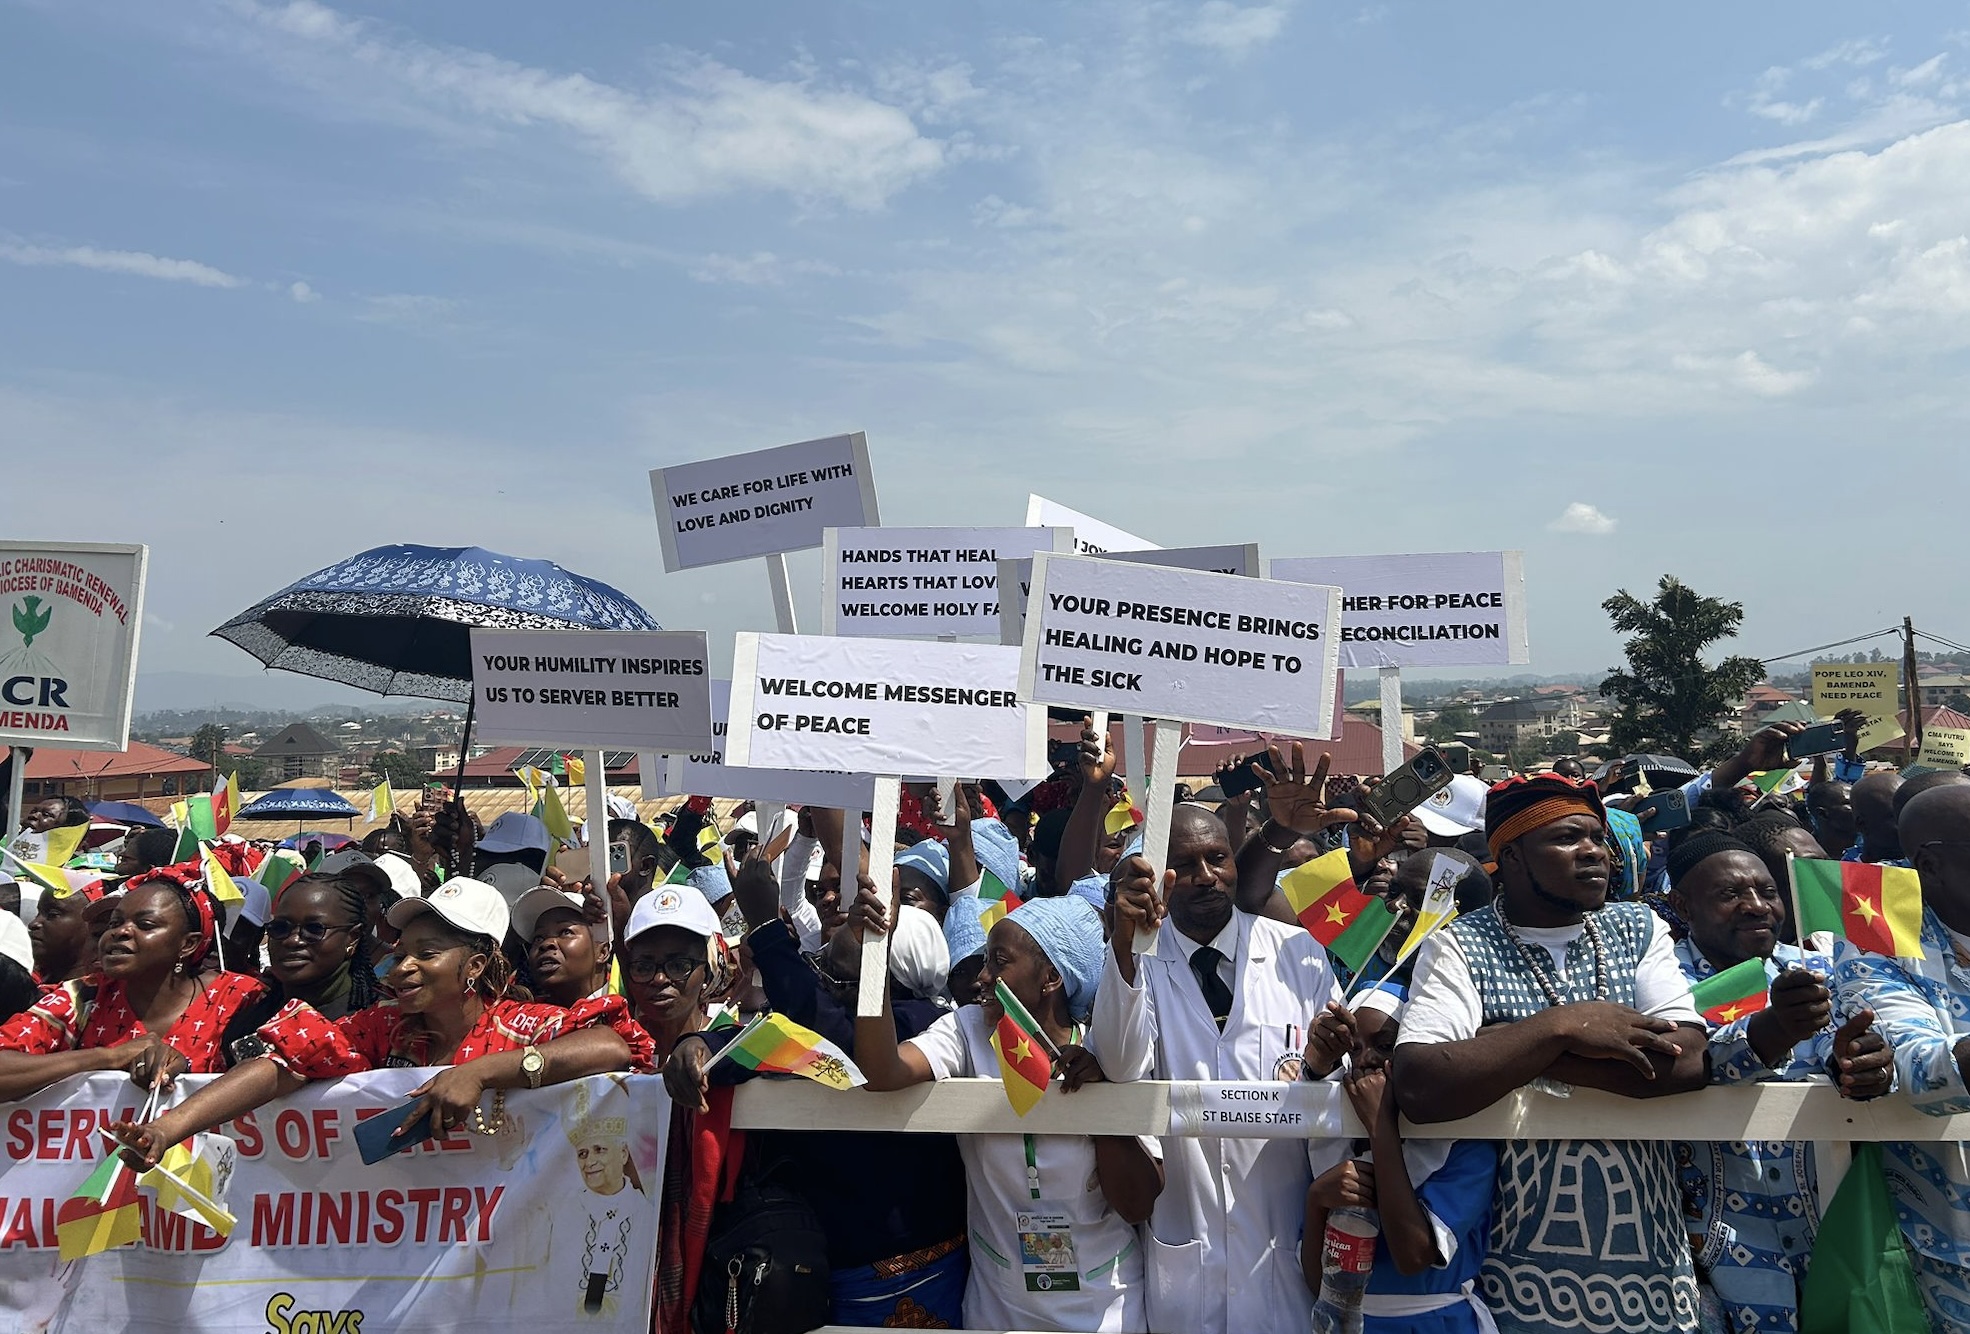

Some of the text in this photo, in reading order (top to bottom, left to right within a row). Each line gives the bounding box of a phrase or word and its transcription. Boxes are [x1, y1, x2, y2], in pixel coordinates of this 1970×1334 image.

[672, 463, 853, 507] WE CARE FOR LIFE WITH
[677, 497, 814, 532] LOVE AND DIGNITY
[842, 550, 997, 563] HANDS THAT HEAL
[0, 558, 129, 626] IC CHARISMATIC RENEWAL
[841, 576, 908, 590] HEARTS
[913, 576, 957, 589] THAT
[40, 576, 54, 592] OF
[55, 579, 104, 617] BAMENDA
[1388, 594, 1429, 610] FOR
[1435, 592, 1503, 609] PEACE
[841, 603, 929, 617] WELCOME
[933, 603, 979, 616] HOLY
[1049, 593, 1320, 641] YOUR PRESENCE BRINGS
[1340, 624, 1499, 642] ECONCILIATION
[1045, 628, 1302, 674] HEALING AND HOPE TO
[483, 655, 703, 675] YOUR HUMILITY INSPIRES
[1042, 663, 1143, 692] THE SICK
[1826, 681, 1876, 689] BAMENDA
[2, 676, 71, 708] CR
[486, 687, 680, 708] US TO SERVER BETTER
[760, 677, 1017, 708] WELCOME MESSENGER
[1850, 691, 1883, 699] PEACE
[757, 712, 871, 735] OF PEACE
[1923, 749, 1955, 757] WELCOME
[1927, 757, 1958, 765] BAMENDA
[1221, 1089, 1279, 1101] SECTION K
[1202, 1111, 1302, 1125] ST BLAISE STAFF
[275, 1109, 339, 1159] OF
[251, 1186, 505, 1247] MINISTRY
